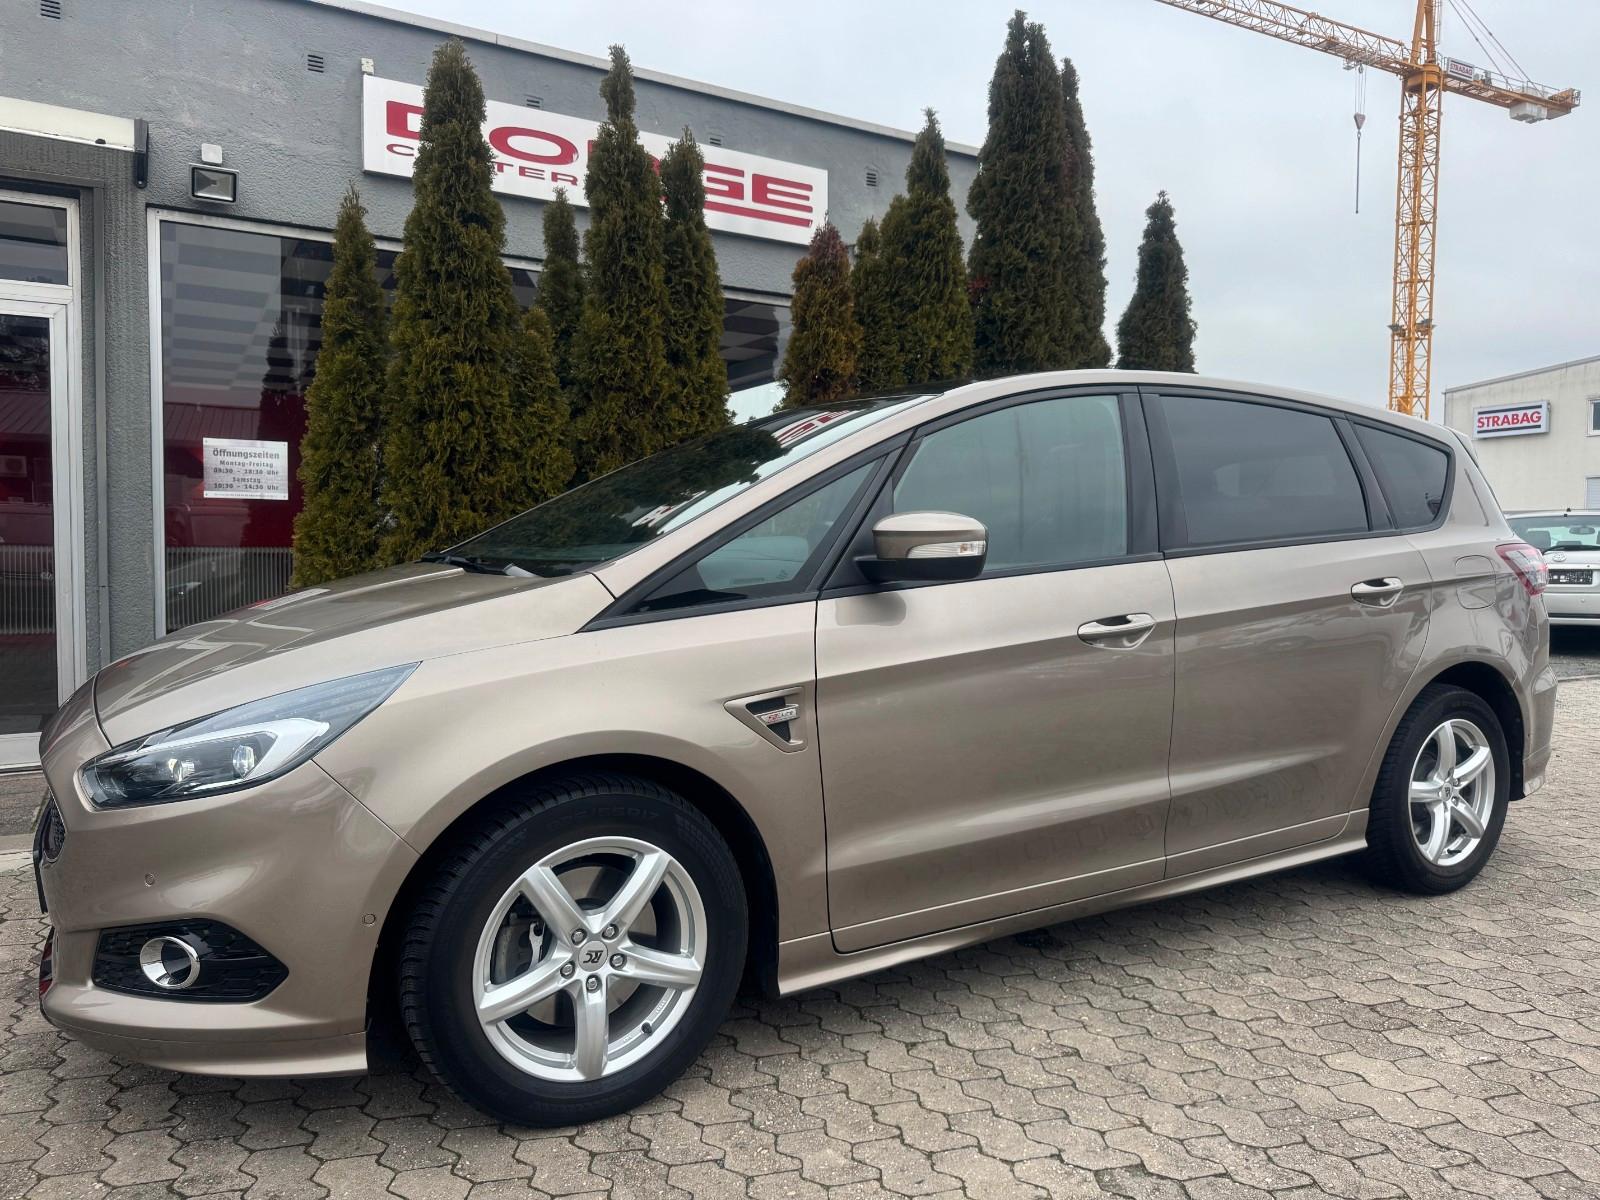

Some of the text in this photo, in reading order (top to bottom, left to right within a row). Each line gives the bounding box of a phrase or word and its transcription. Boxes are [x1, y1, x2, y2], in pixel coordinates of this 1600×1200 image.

[1450, 63, 1472, 75] STRABAG
[386, 143, 578, 186] CTER
[1477, 411, 1542, 428] STRABAG
[213, 448, 279, 459] Öffnungszeiten
